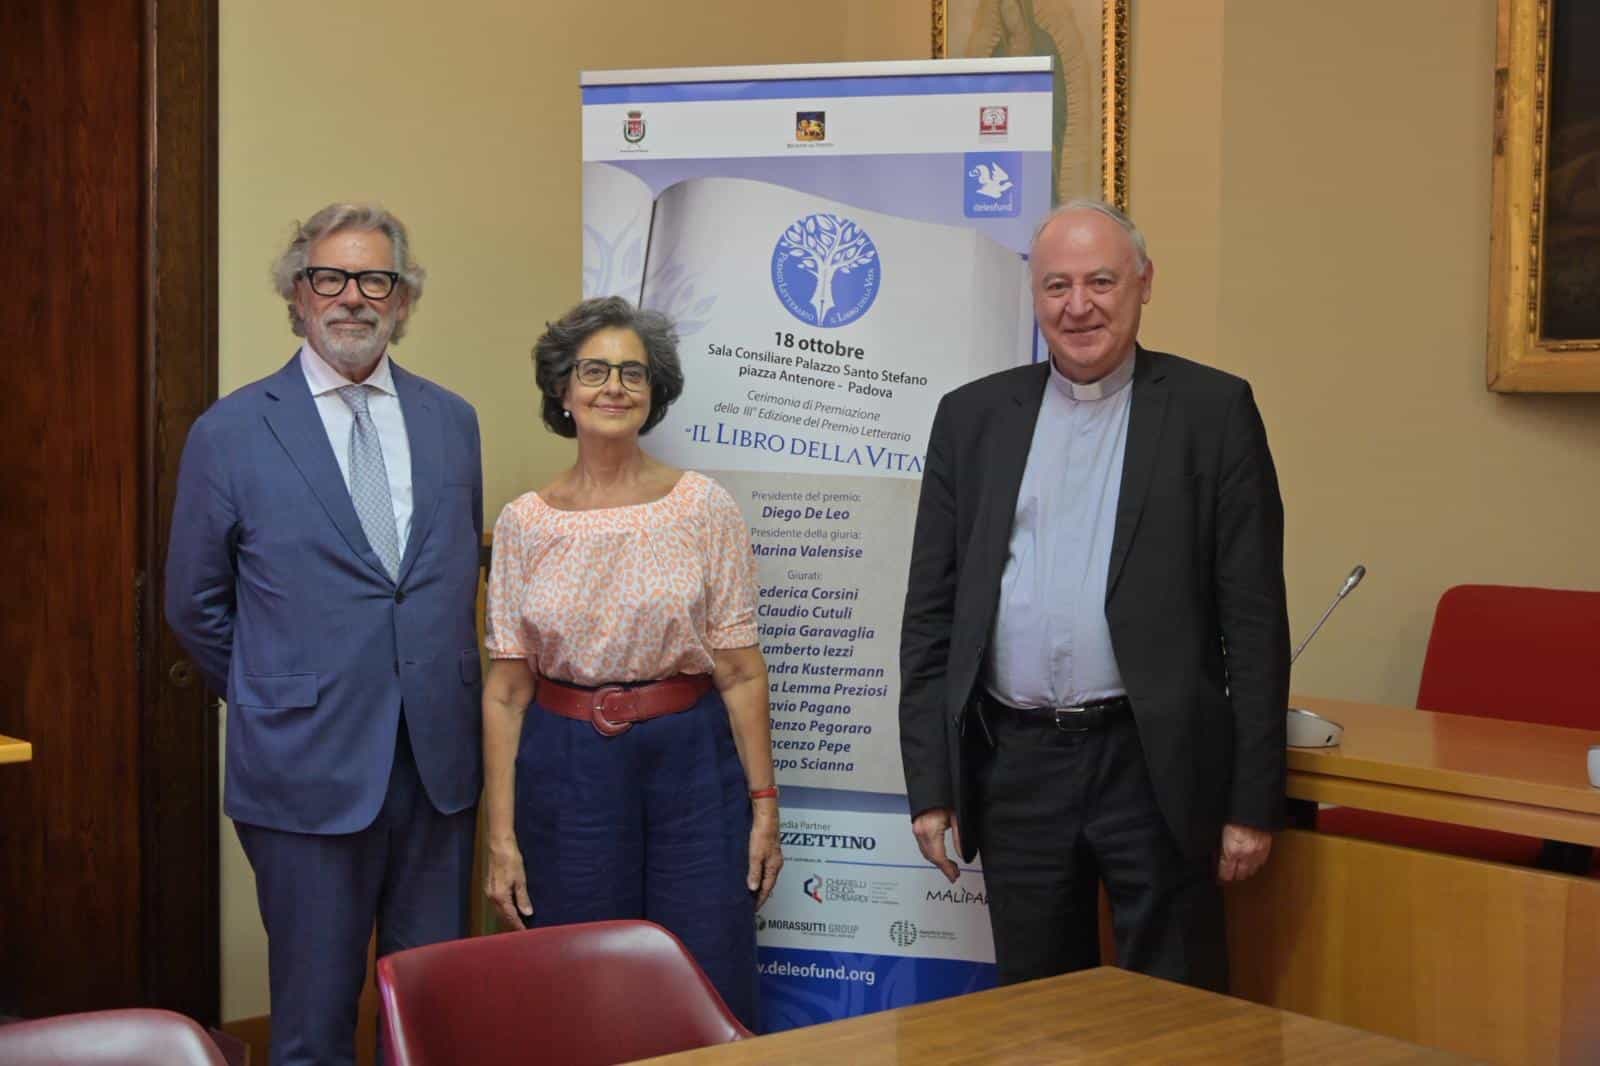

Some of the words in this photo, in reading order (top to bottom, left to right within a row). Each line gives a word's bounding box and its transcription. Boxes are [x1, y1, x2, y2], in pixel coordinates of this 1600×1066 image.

[775, 331, 794, 348] 18
[798, 338, 865, 360] ottobre
[708, 343, 732, 357] Sala
[735, 346, 793, 367] Consiliare
[795, 356, 841, 374] Palazzo
[843, 364, 879, 381] Santo
[881, 369, 928, 386] Stefano
[738, 365, 777, 380] piazza
[779, 370, 836, 390] Antenore
[848, 381, 893, 398] Padova
[747, 390, 801, 408] Cerimonia
[802, 400, 813, 410] di
[814, 401, 881, 421] Premiazione
[713, 402, 740, 415] della
[758, 408, 802, 425] Edizione
[803, 416, 821, 428] del
[821, 419, 860, 434] Premio
[860, 426, 912, 442] Letterario
[716, 423, 785, 453] LIBRO
[790, 438, 863, 466] DELLA
[751, 490, 803, 501] Presidente
[804, 491, 822, 501] del
[823, 492, 862, 504] premio:
[762, 505, 802, 522] Diego
[804, 507, 823, 519] De
[825, 507, 850, 520] Leo
[751, 527, 803, 538] Presidente
[803, 527, 828, 538] della
[751, 543, 798, 557] Marina
[800, 545, 864, 559] Valensise
[758, 585, 809, 599] ederica
[811, 586, 860, 600] Corsini
[758, 604, 809, 618] Claudio
[812, 606, 854, 619] Cutuli
[757, 623, 797, 639] riapia
[799, 624, 875, 642] Garavaglia
[762, 643, 821, 656] amberto
[823, 644, 855, 657] Iezzi
[801, 662, 885, 678] Kustermann
[782, 681, 832, 695] Lemma
[834, 683, 888, 697] Preziosi
[800, 700, 852, 717] Pagano
[809, 720, 872, 737] Pegoraro
[818, 739, 852, 755] Pepe
[800, 757, 855, 772] Scianna
[800, 821, 832, 832] Partner
[779, 831, 877, 851] ZZETTINO
[768, 919, 827, 933] MORASSUTTI
[828, 922, 859, 935] GROUP
